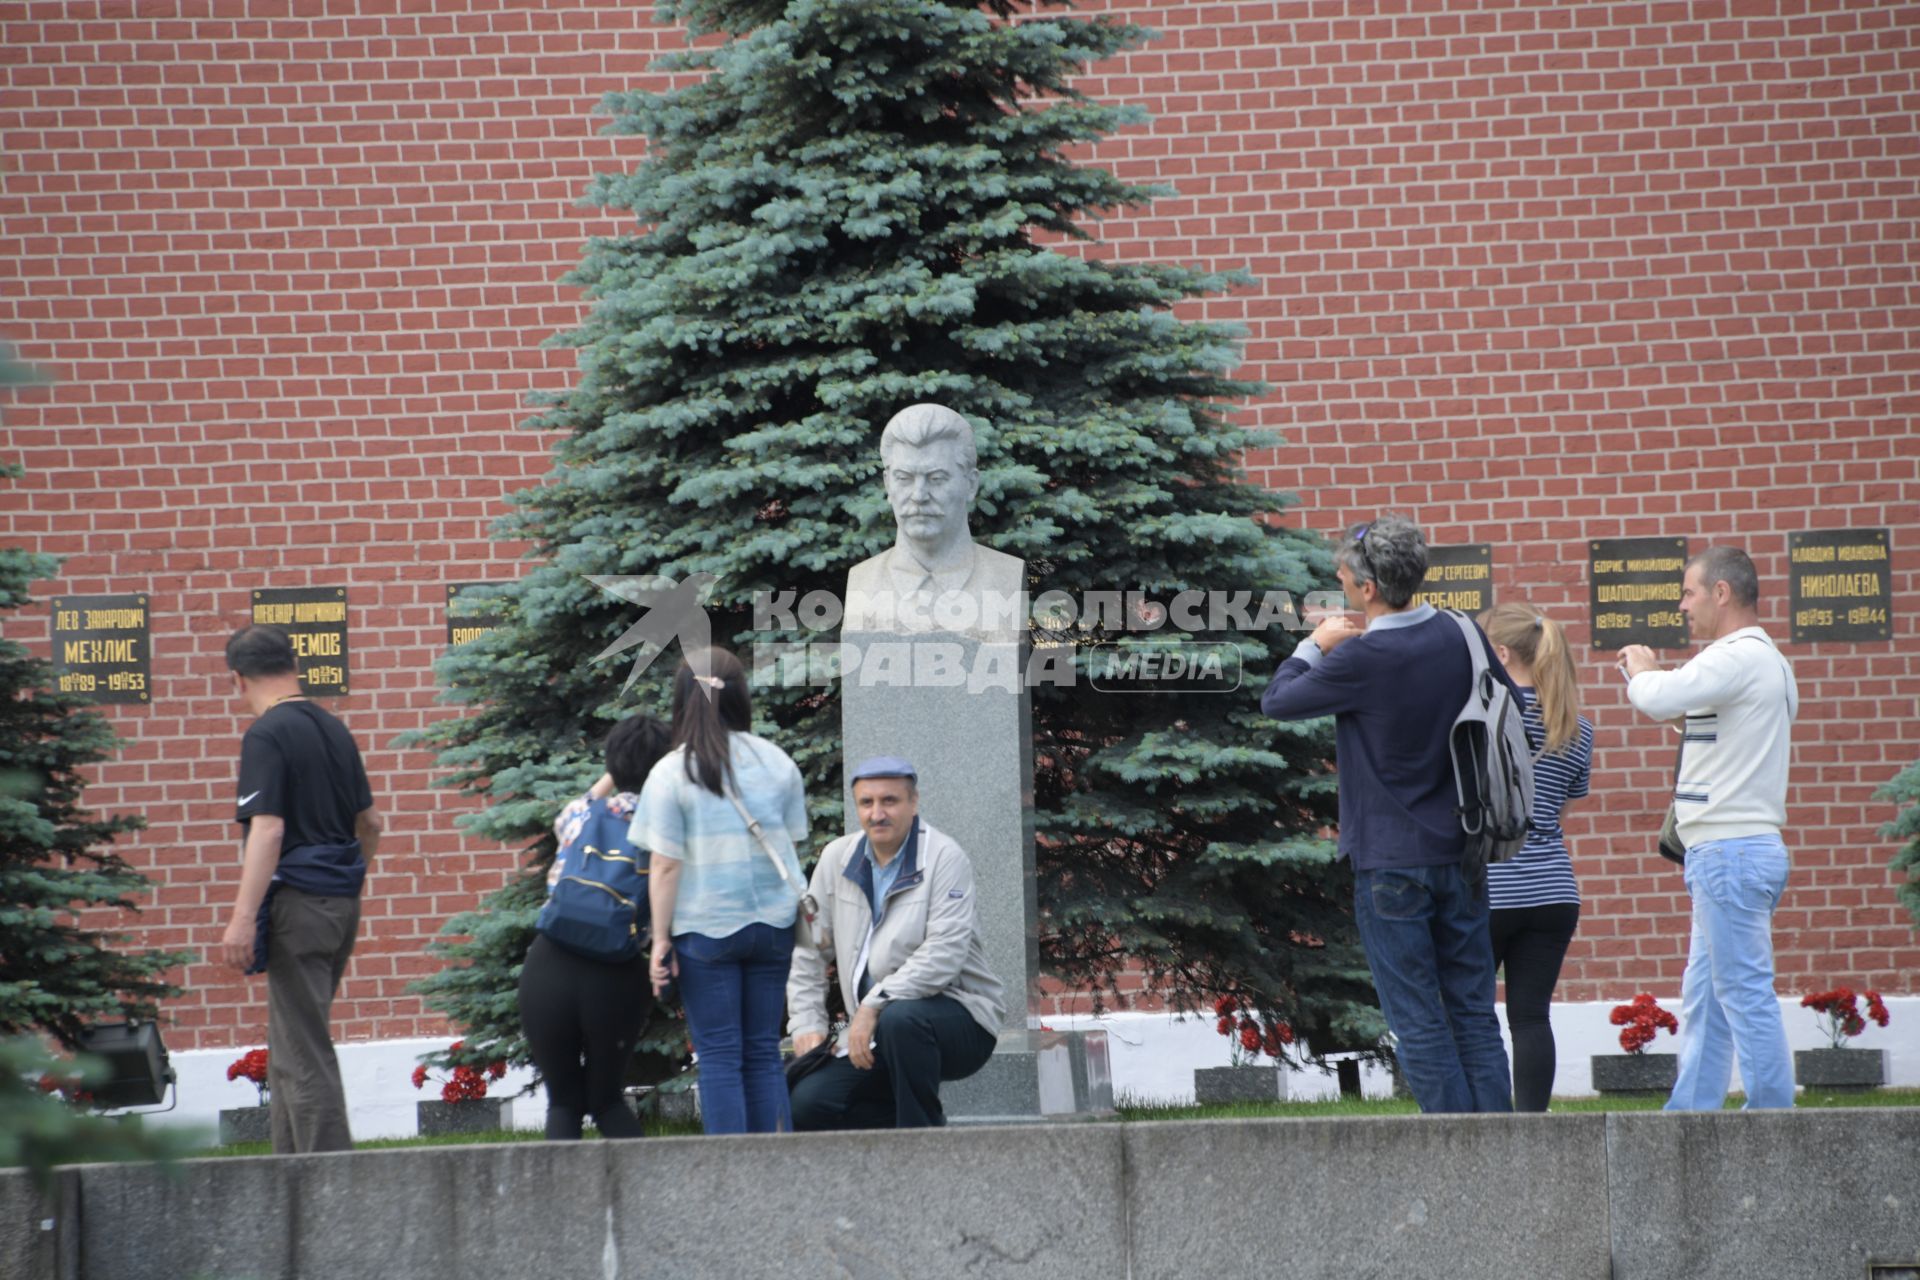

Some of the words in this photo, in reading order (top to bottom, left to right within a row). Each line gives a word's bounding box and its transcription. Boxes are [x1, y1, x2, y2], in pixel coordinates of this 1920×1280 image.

[1445, 564, 1489, 580] СЕРГЕЕВИЧ
[1594, 560, 1624, 573] БОРИС
[1598, 583, 1681, 602] ШАПОШНИКОВ
[1801, 573, 1880, 598] НИКОЛАЕВА
[56, 610, 79, 630] ЛЕВ
[84, 608, 144, 629] ЗАХАРОВИЧ
[64, 639, 137, 663] МЕХЛИС
[288, 632, 341, 657] РЕМОВ
